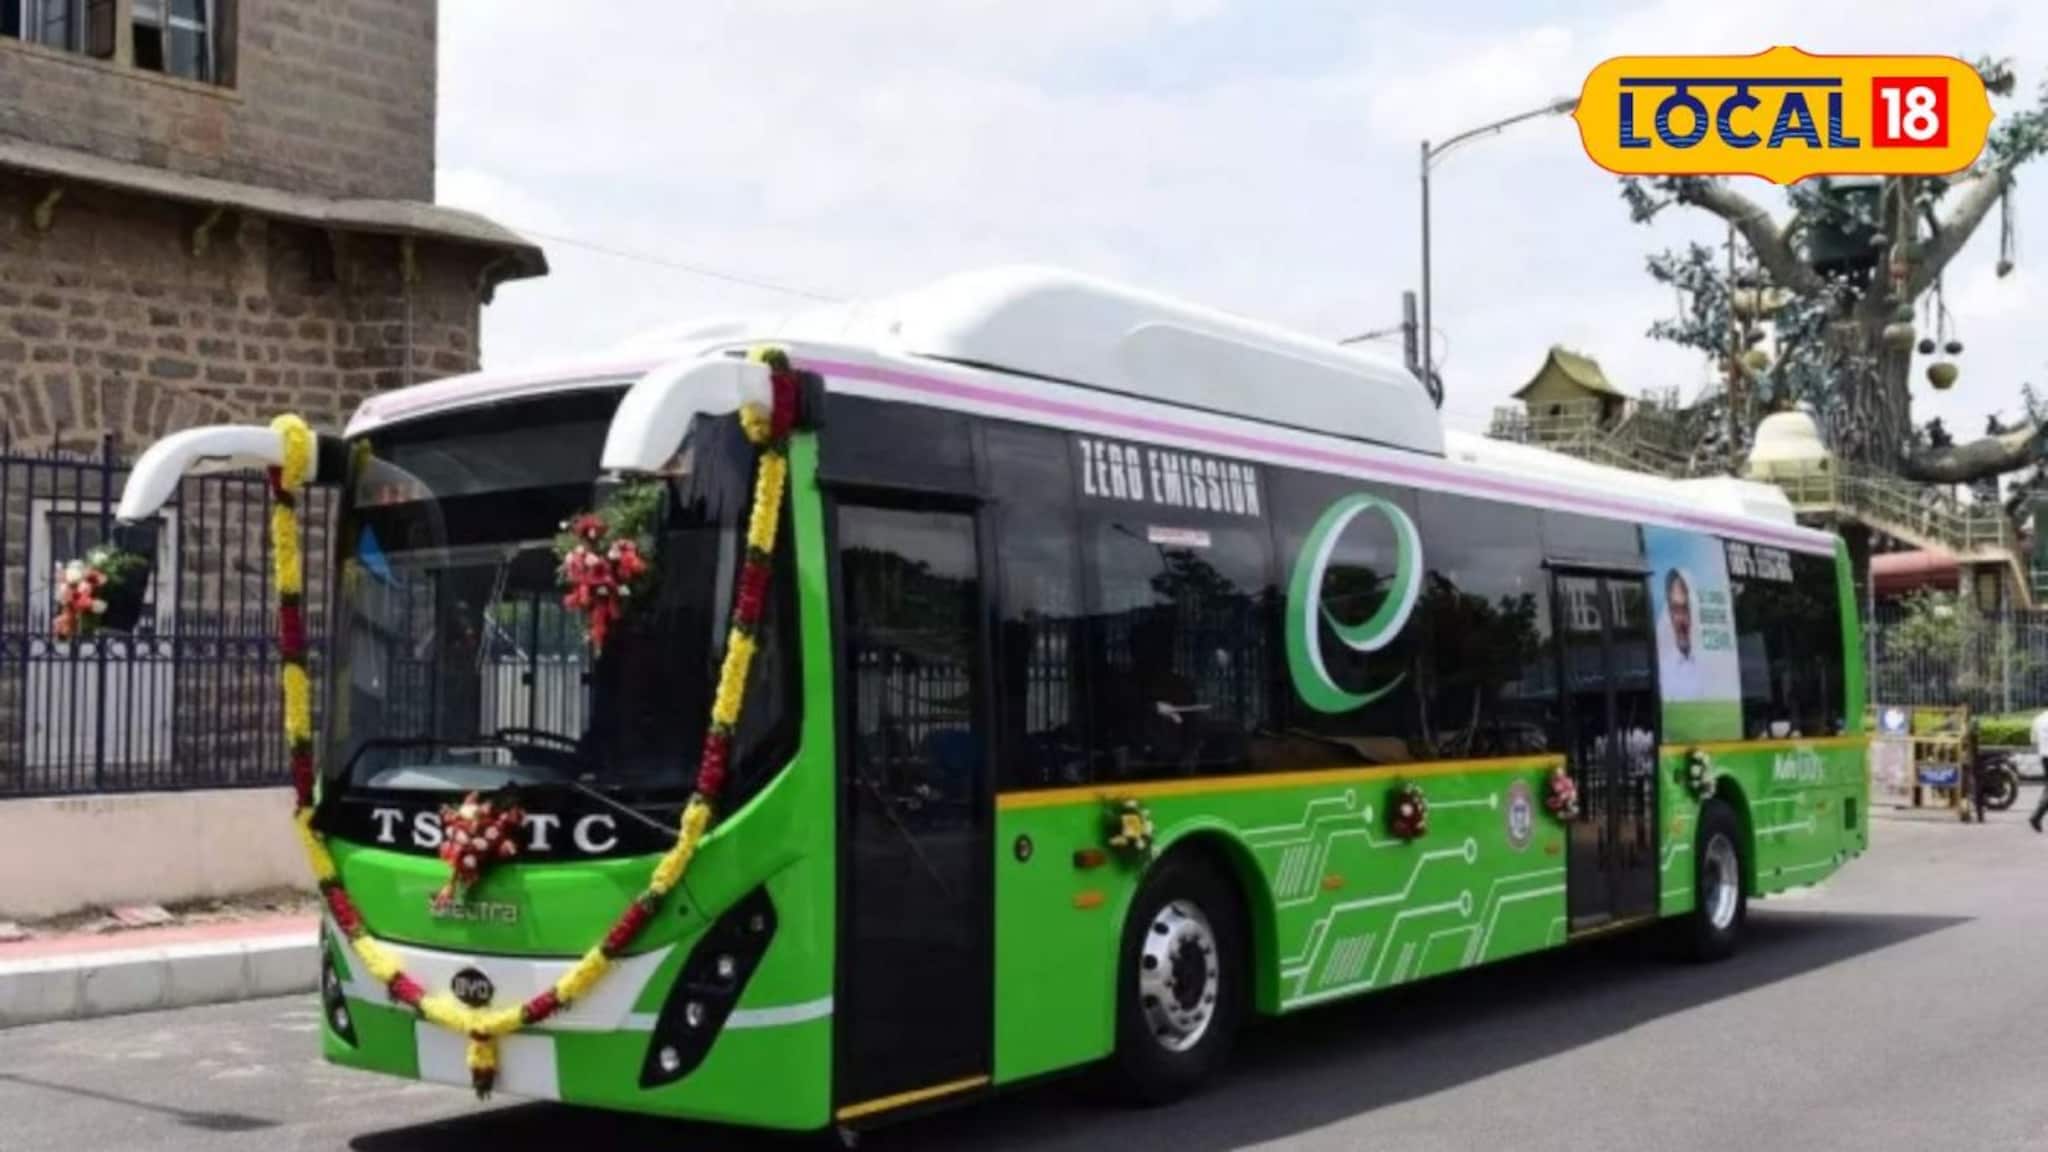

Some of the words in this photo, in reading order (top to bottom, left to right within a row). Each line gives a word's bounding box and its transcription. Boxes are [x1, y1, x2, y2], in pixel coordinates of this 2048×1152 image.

[1079, 438, 1144, 501] ZERO
[1147, 449, 1261, 518] EMISSION
[372, 807, 619, 854] TSTC
